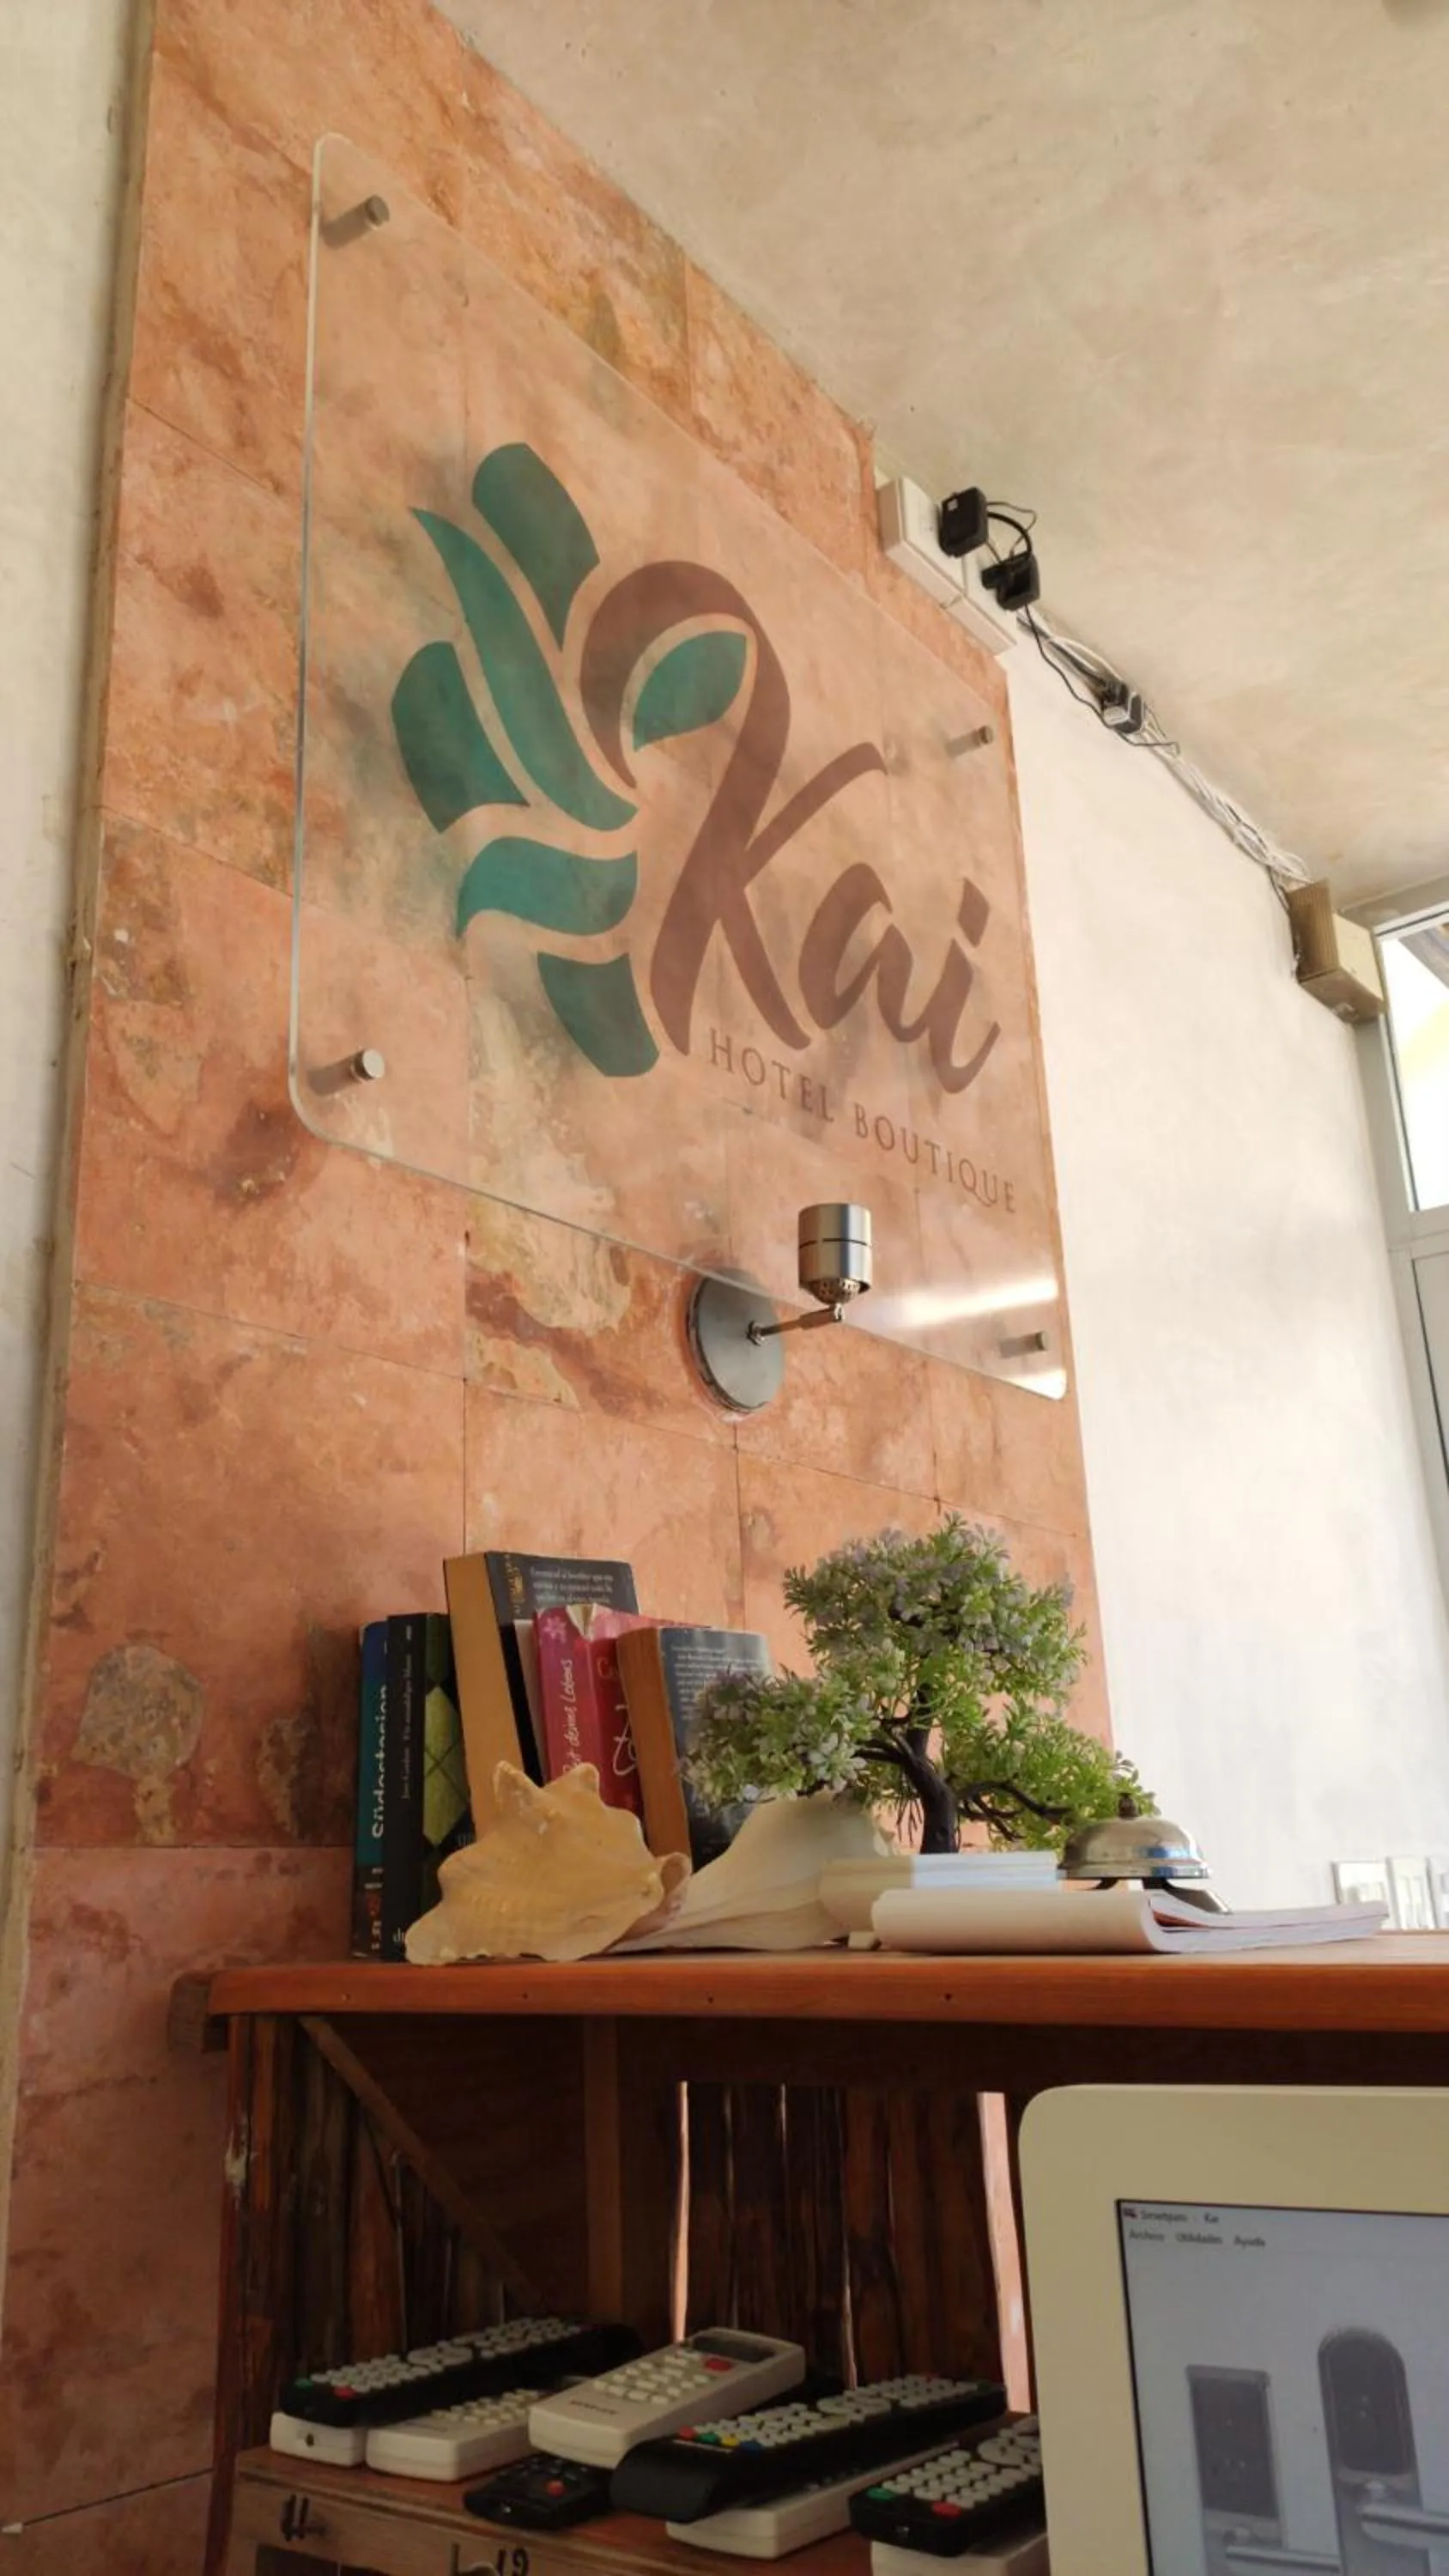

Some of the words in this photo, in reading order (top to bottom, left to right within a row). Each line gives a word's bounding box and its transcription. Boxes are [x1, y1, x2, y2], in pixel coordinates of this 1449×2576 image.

[580, 560, 1001, 1094] Kai
[709, 1028, 834, 1123] HOTEL
[854, 1103, 1017, 1214] BOUTIQUE
